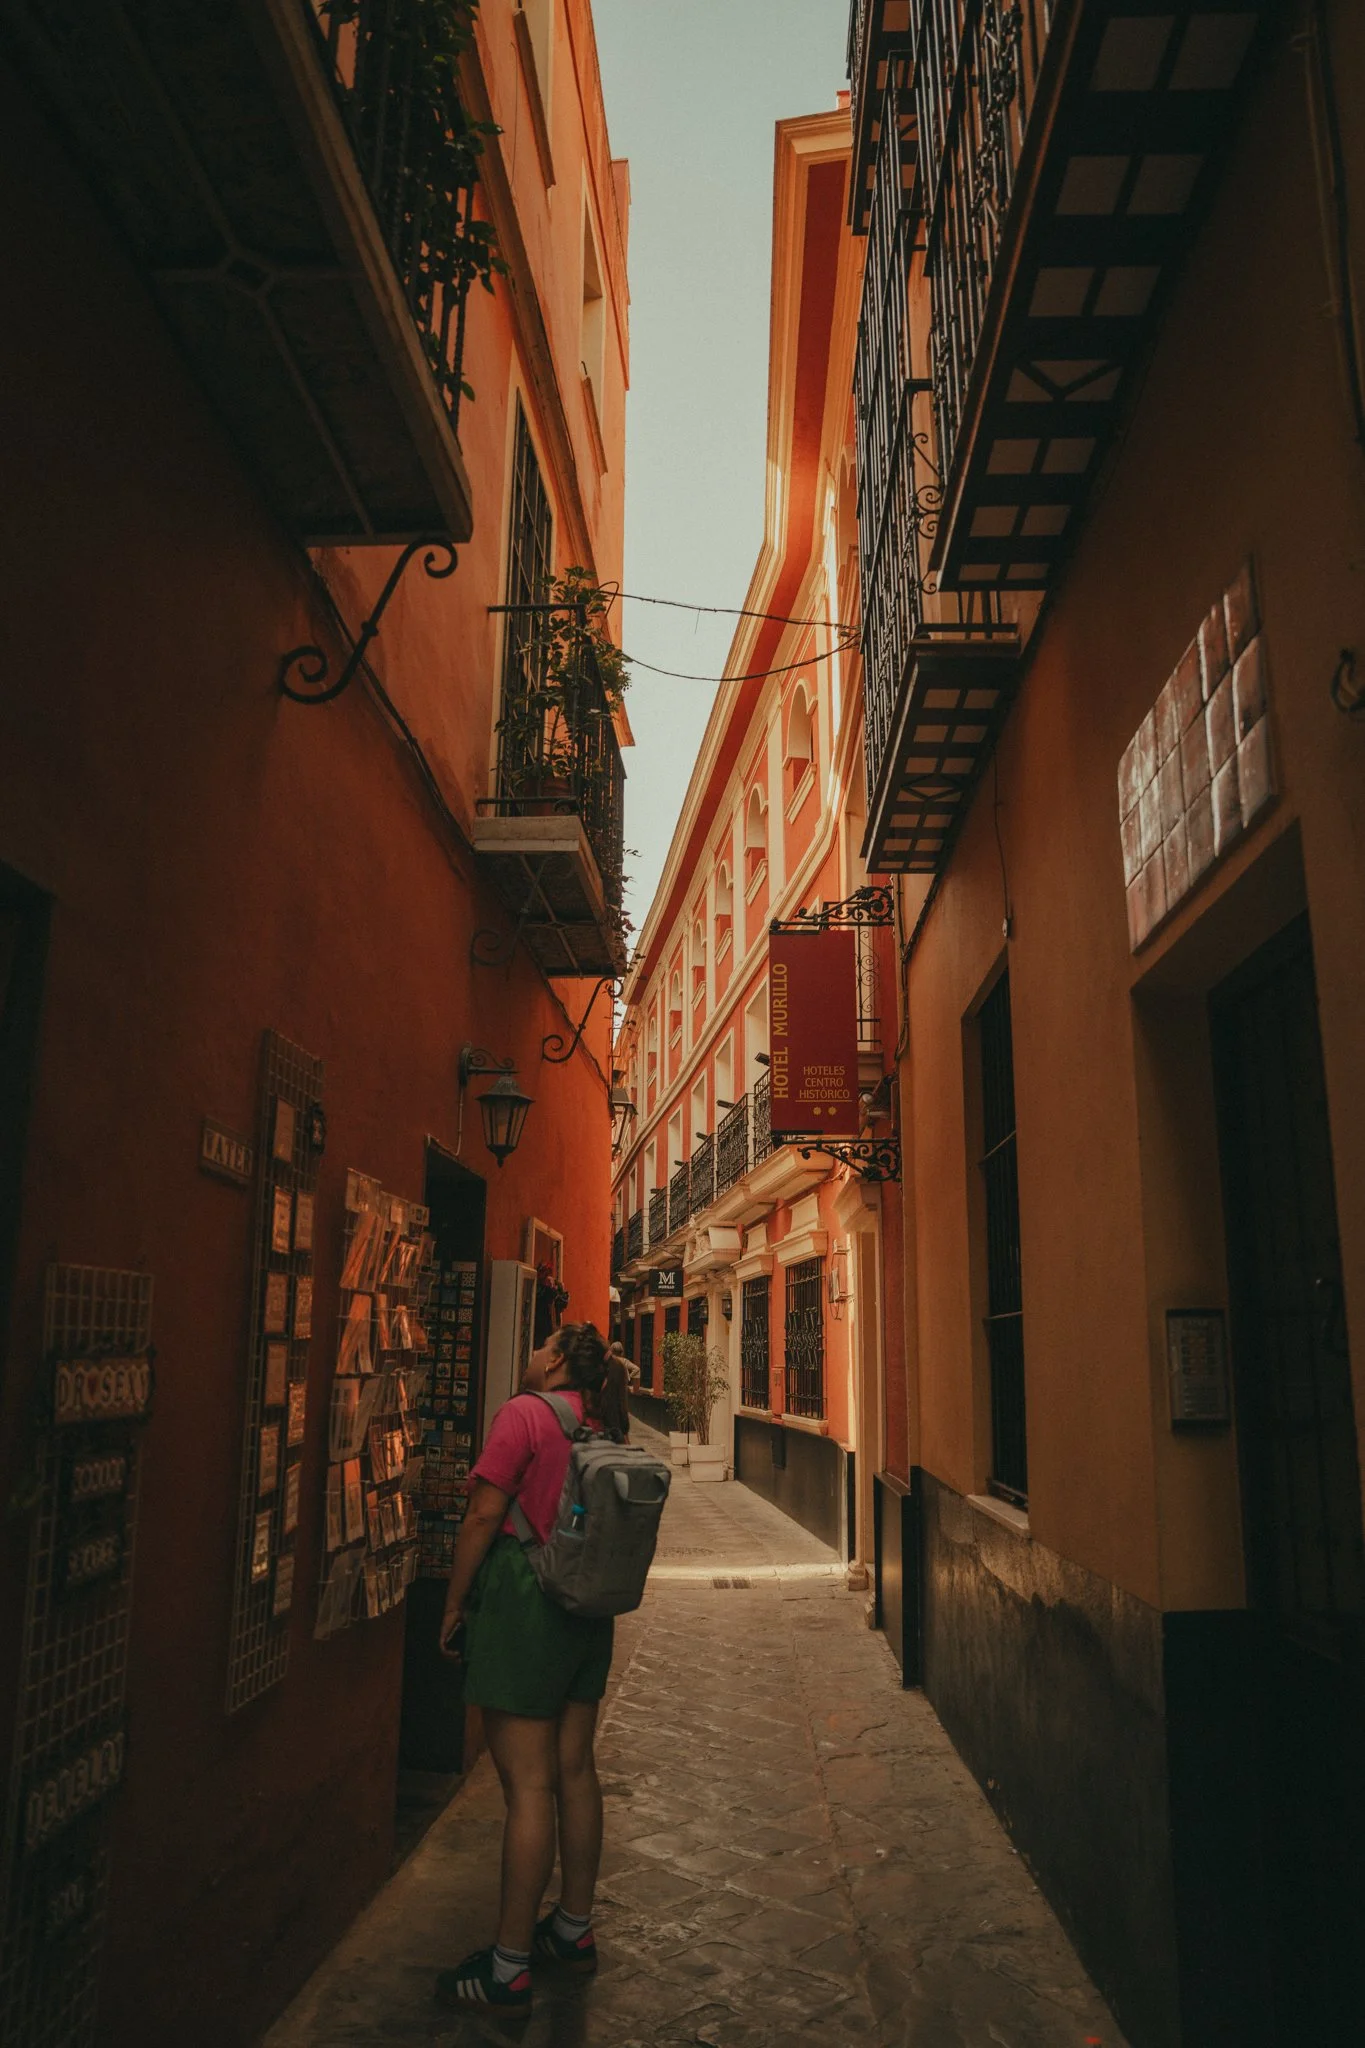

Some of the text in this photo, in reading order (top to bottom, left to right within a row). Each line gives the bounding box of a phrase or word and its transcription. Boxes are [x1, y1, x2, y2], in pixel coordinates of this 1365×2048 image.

[772, 963, 789, 1099] HOTEL MURILLO
[803, 1065, 846, 1076] HOTELES
[804, 1077, 844, 1088] CENTRO
[799, 1087, 850, 1099] HISTÓRICO
[658, 1271, 676, 1285] M
